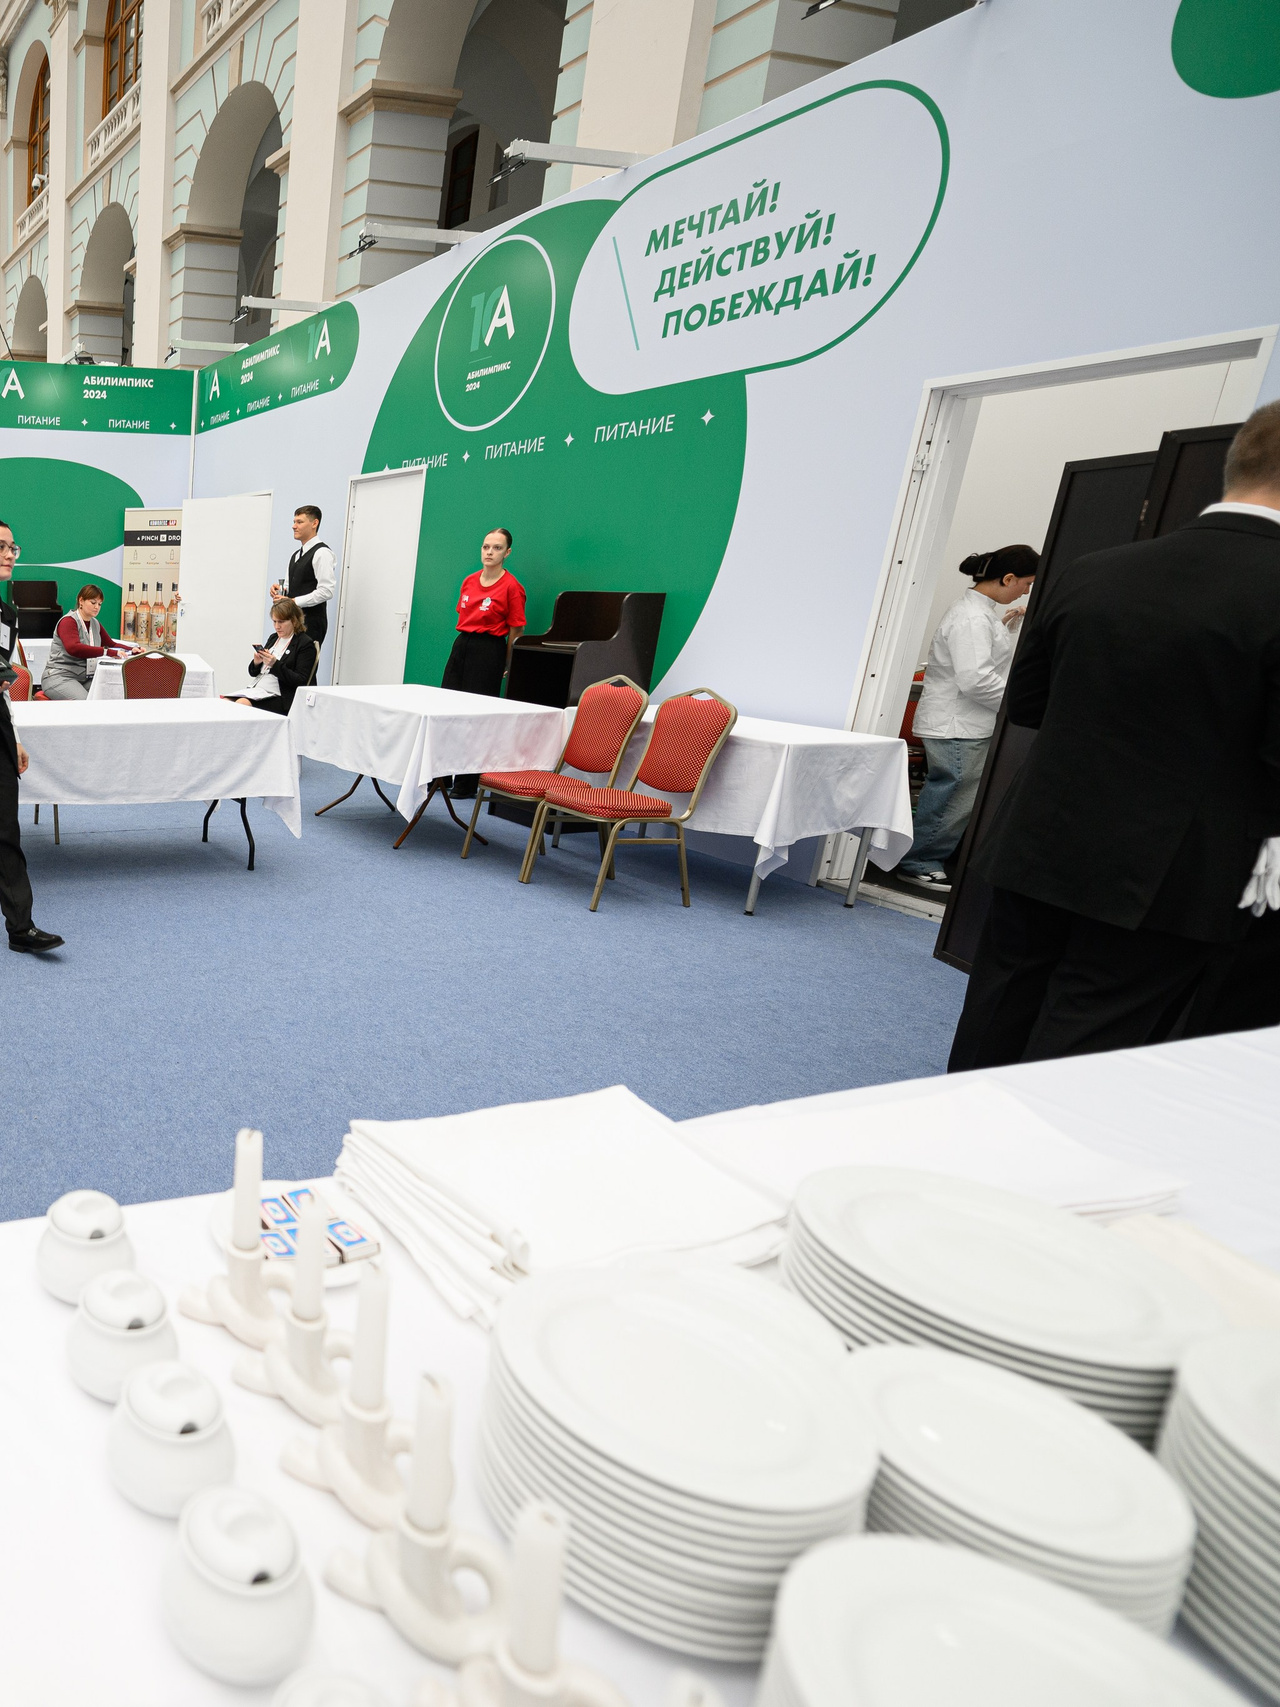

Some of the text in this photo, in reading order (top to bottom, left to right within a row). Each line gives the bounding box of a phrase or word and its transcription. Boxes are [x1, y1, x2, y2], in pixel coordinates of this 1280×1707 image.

[644, 177, 781, 258] МЕЧТАЙ!
[653, 209, 837, 303] ДЕЙСТВУЙ!
[661, 249, 878, 338] ПОБЕЖДАЙ!
[241, 344, 280, 370] АБИЛИМПИКС
[83, 375, 154, 388] АБИЛИМПИКС
[240, 371, 253, 385] 2024
[466, 361, 511, 380] АБИЛИМПИКС
[83, 389, 107, 399] 2024
[247, 396, 270, 412] ПИТАНИЕ
[291, 378, 320, 398] ПИТАНИЕ
[465, 381, 480, 392] 2024
[17, 414, 61, 426] ПИТАНИЕ
[108, 418, 150, 430] ПИТАНИЕ
[485, 436, 545, 460] ПИТАНИЕ
[593, 414, 675, 444] ПИТАНИЕ
